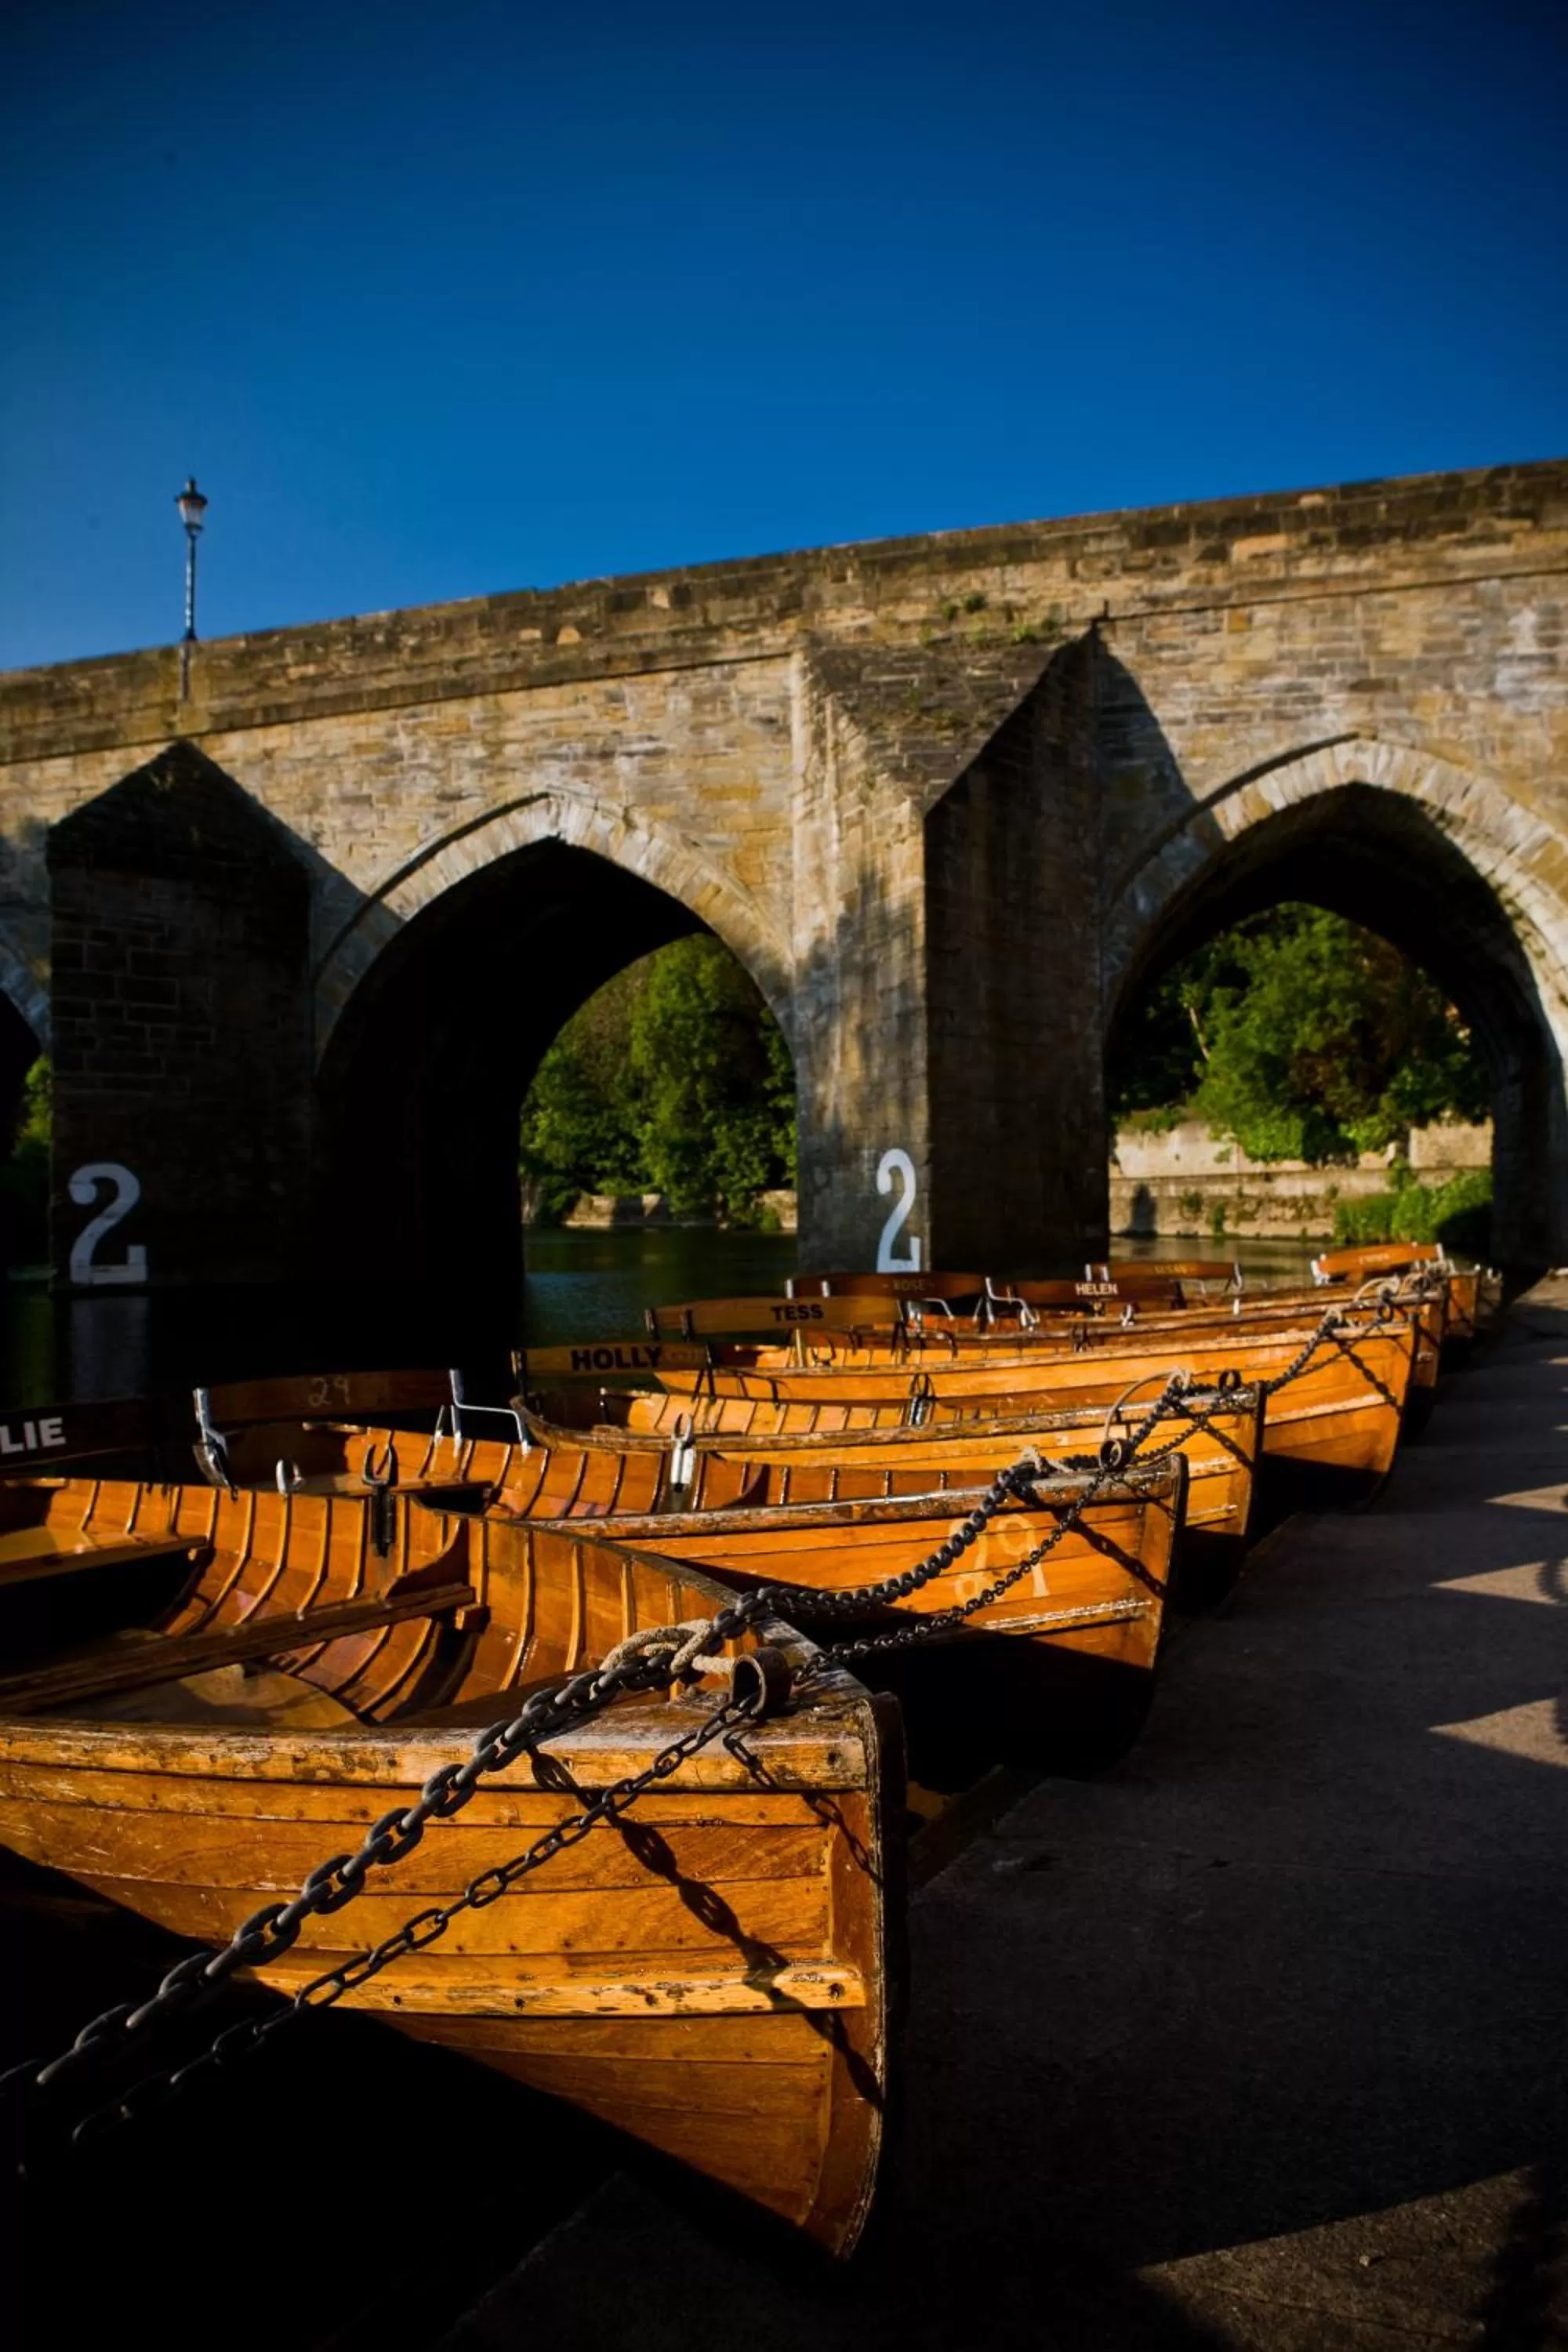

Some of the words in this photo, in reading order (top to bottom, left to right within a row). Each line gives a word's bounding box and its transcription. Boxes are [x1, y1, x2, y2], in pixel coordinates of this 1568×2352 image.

[876, 1148, 921, 1273] 2
[67, 1162, 148, 1285] 2
[1075, 1283, 1119, 1297] HELEN
[771, 1304, 825, 1321] TESS
[572, 1346, 661, 1370] HOLLY
